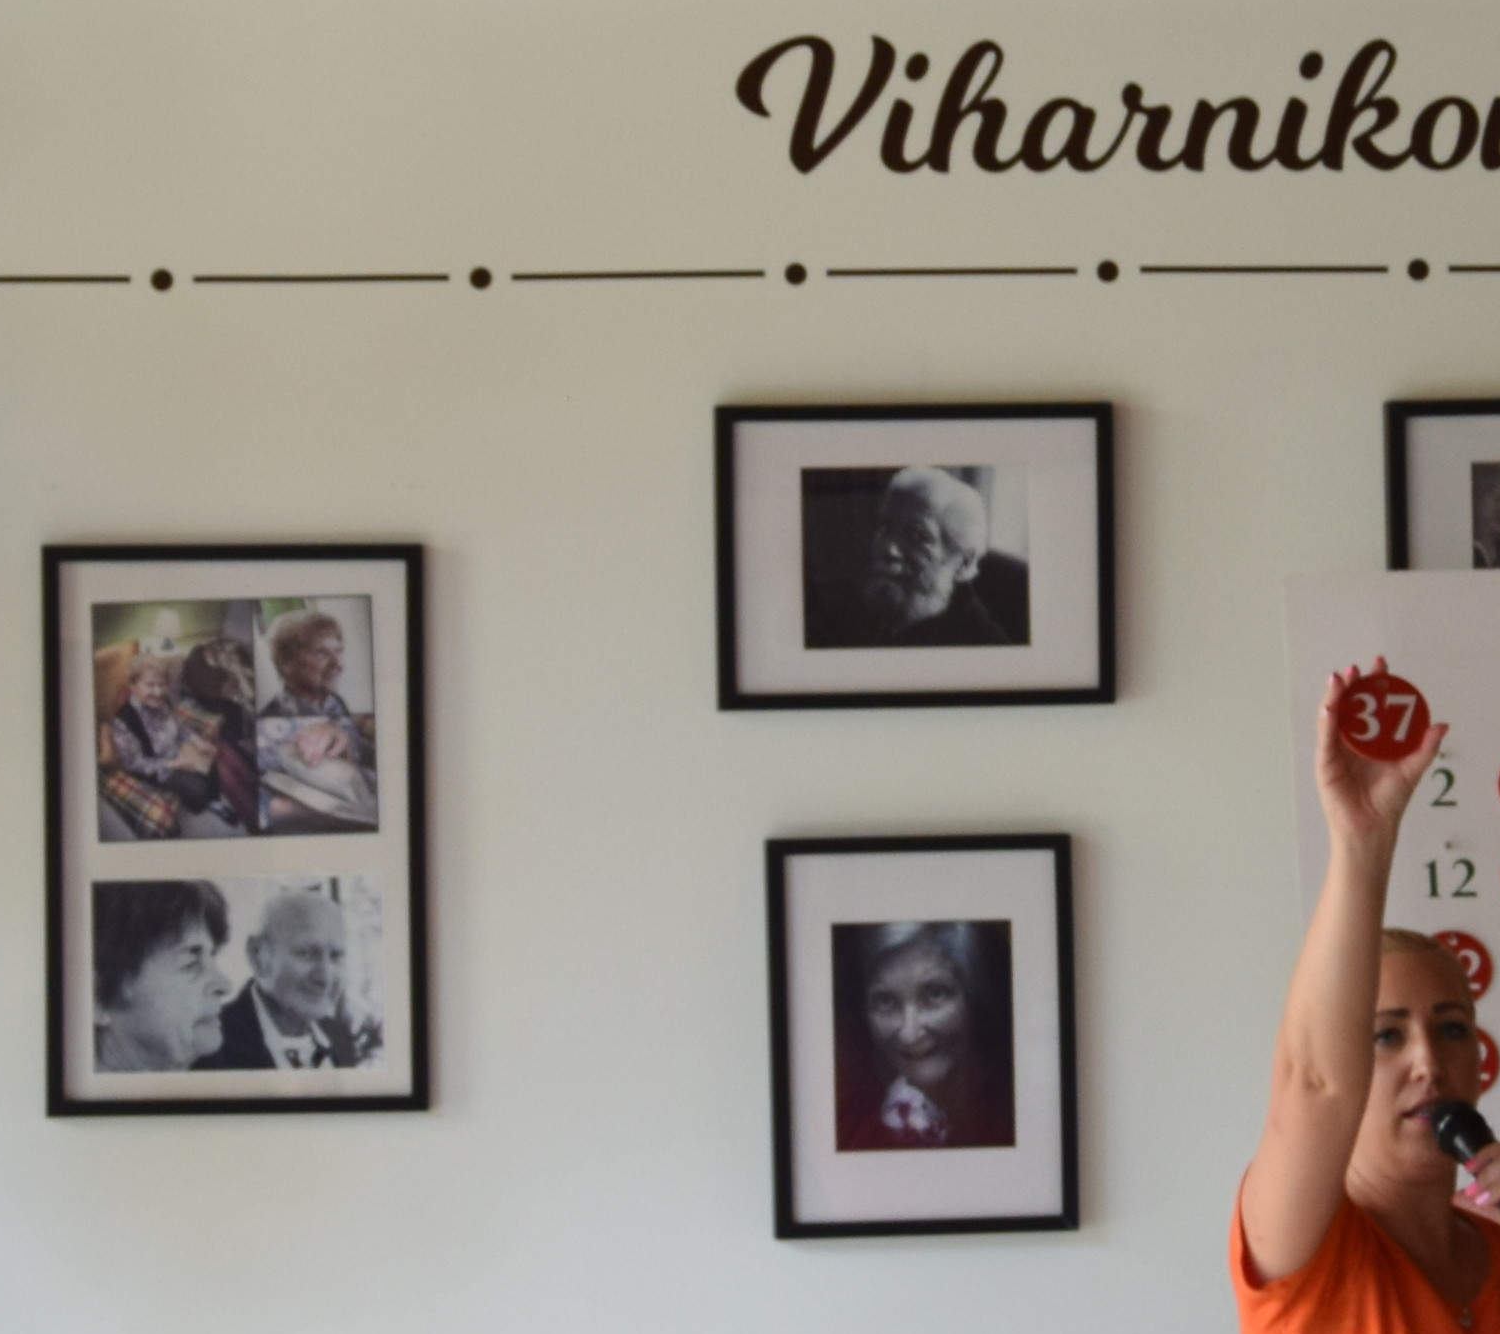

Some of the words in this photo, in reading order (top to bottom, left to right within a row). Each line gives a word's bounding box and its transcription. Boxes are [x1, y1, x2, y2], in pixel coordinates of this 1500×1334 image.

[1350, 692, 1418, 743] 37
[1431, 768, 1457, 807] 2
[1425, 858, 1478, 898] 12
[1457, 948, 1483, 990] 2
